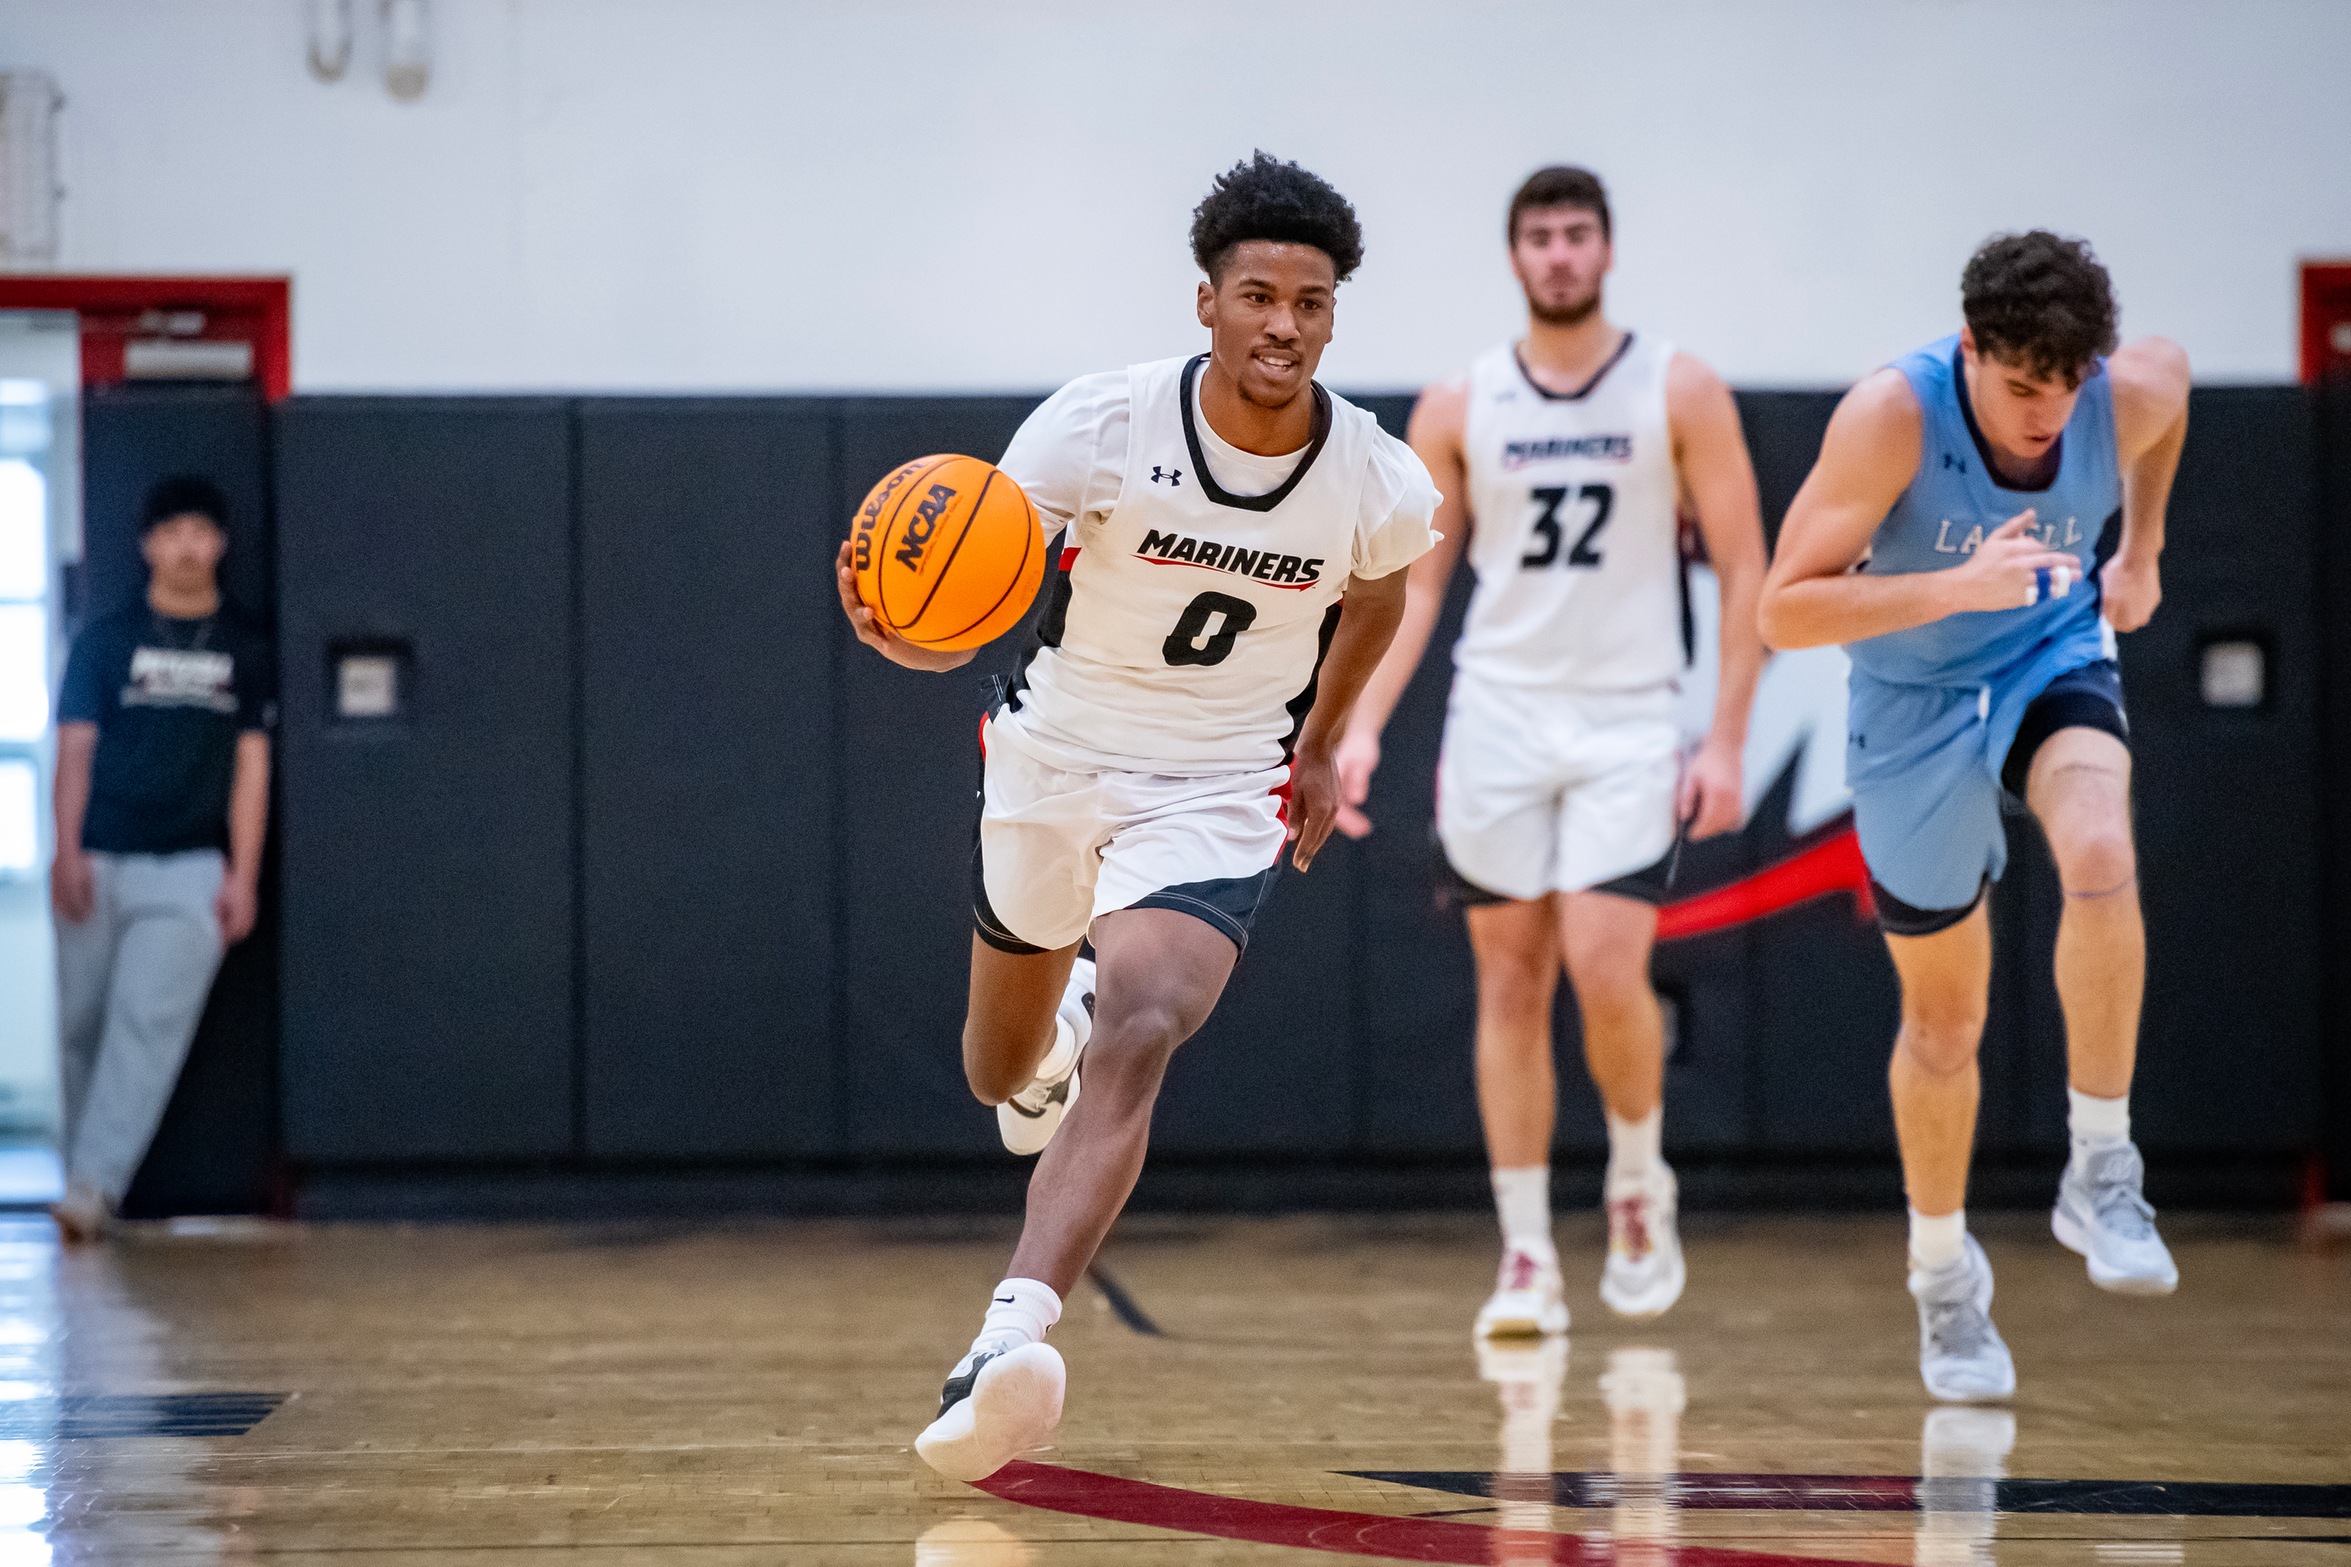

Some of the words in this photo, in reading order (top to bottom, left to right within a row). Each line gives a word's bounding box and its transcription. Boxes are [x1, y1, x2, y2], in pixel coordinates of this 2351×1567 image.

[896, 484, 956, 572] NCAA
[1136, 529, 1325, 584] MARINERS
[1521, 484, 1614, 569] 32
[1934, 516, 2083, 554] LALL
[1161, 590, 1258, 667] 0
